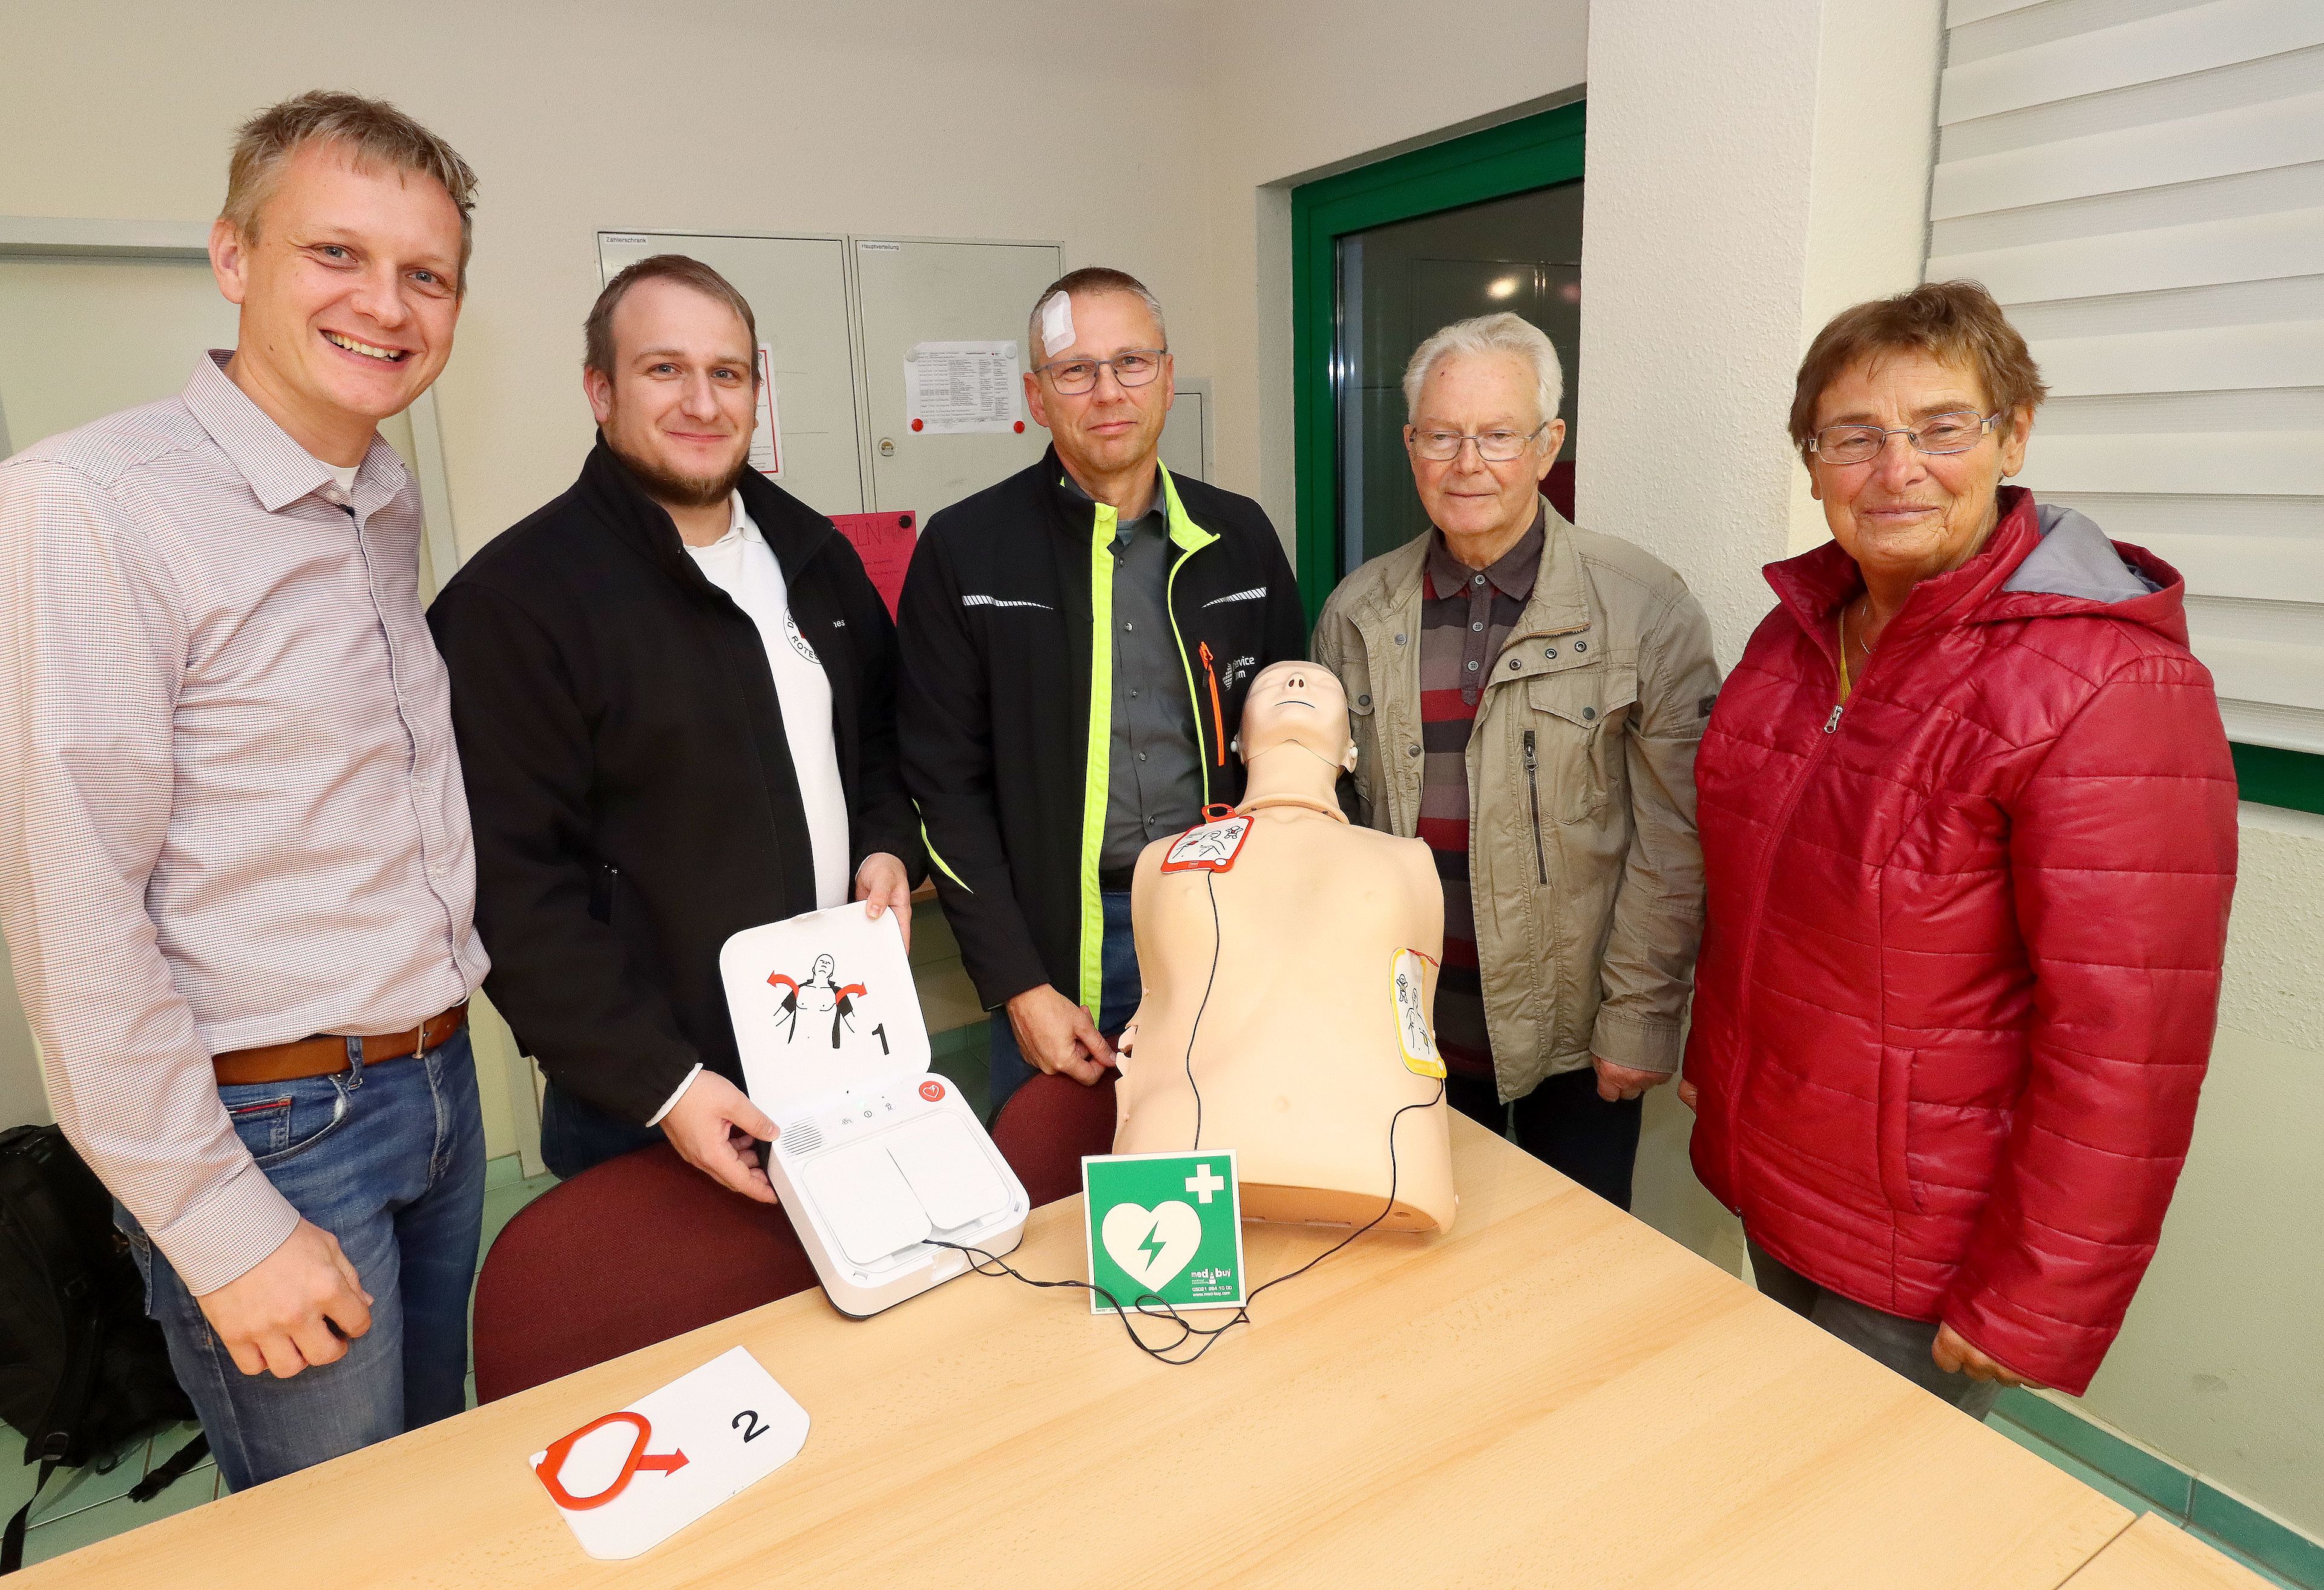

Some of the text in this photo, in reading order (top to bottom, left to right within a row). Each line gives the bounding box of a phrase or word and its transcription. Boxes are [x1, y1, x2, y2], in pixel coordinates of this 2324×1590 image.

[792, 635, 819, 660] ROTES
[872, 1023, 889, 1055] 1
[732, 1410, 770, 1443] 2
